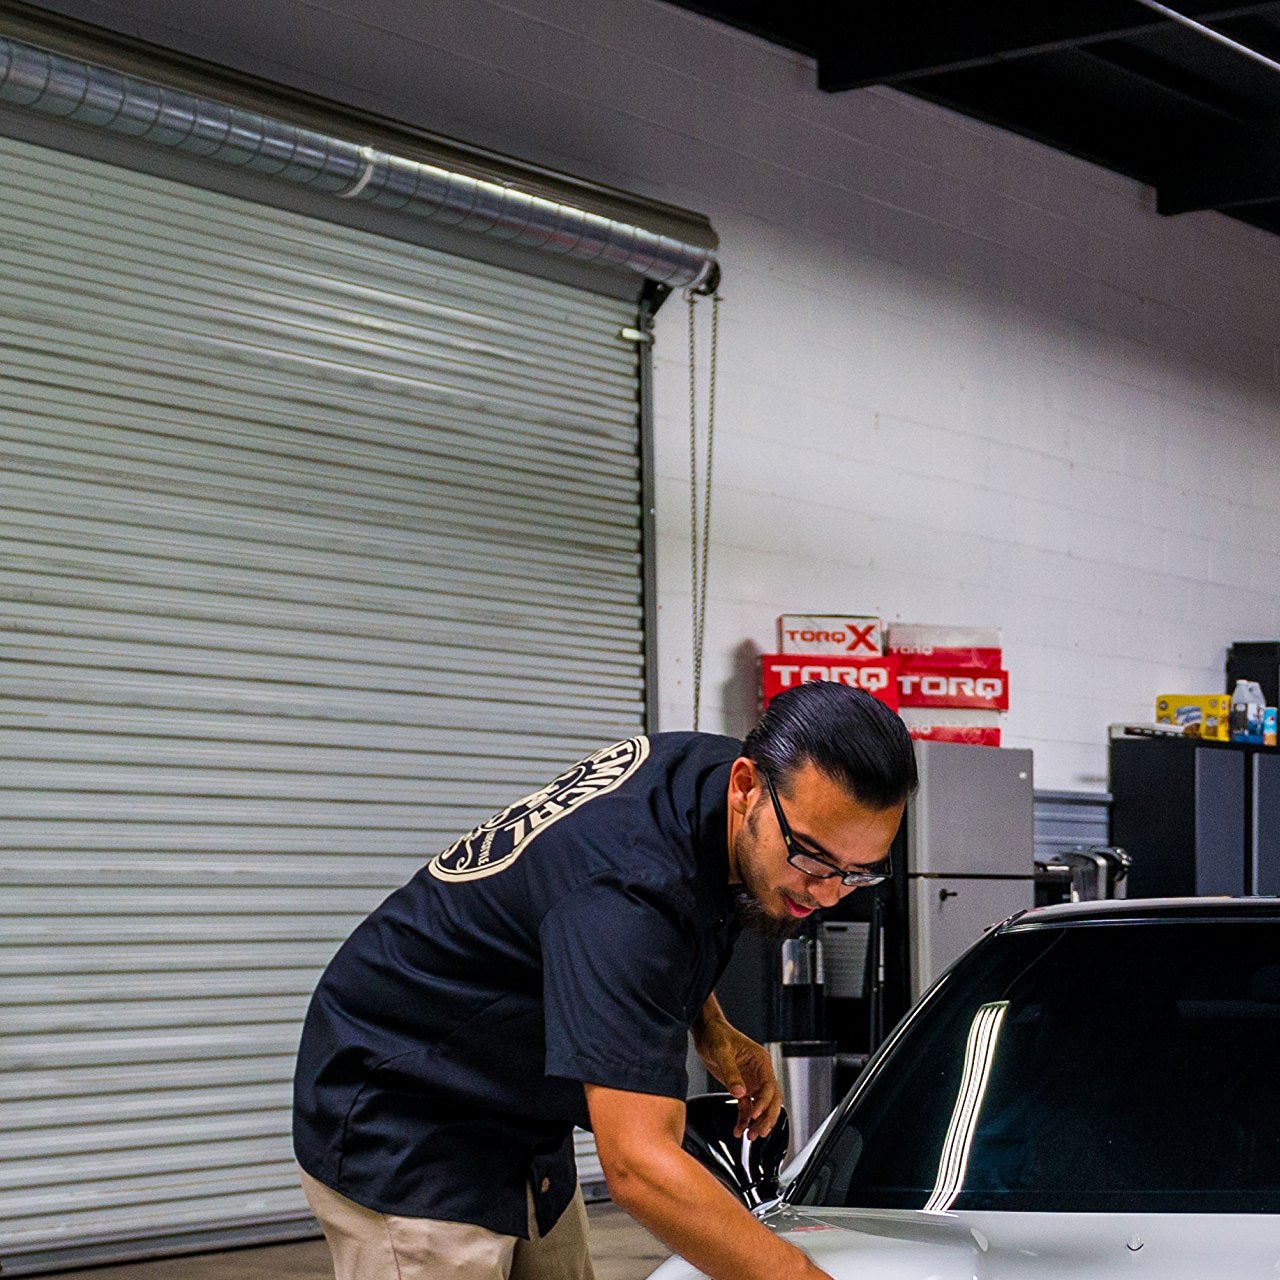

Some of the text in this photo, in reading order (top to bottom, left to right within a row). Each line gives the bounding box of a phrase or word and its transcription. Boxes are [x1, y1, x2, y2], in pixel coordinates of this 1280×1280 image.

[770, 664, 888, 692] TORQ
[897, 675, 1002, 700] TORQ
[503, 740, 634, 846] HEMICAL
